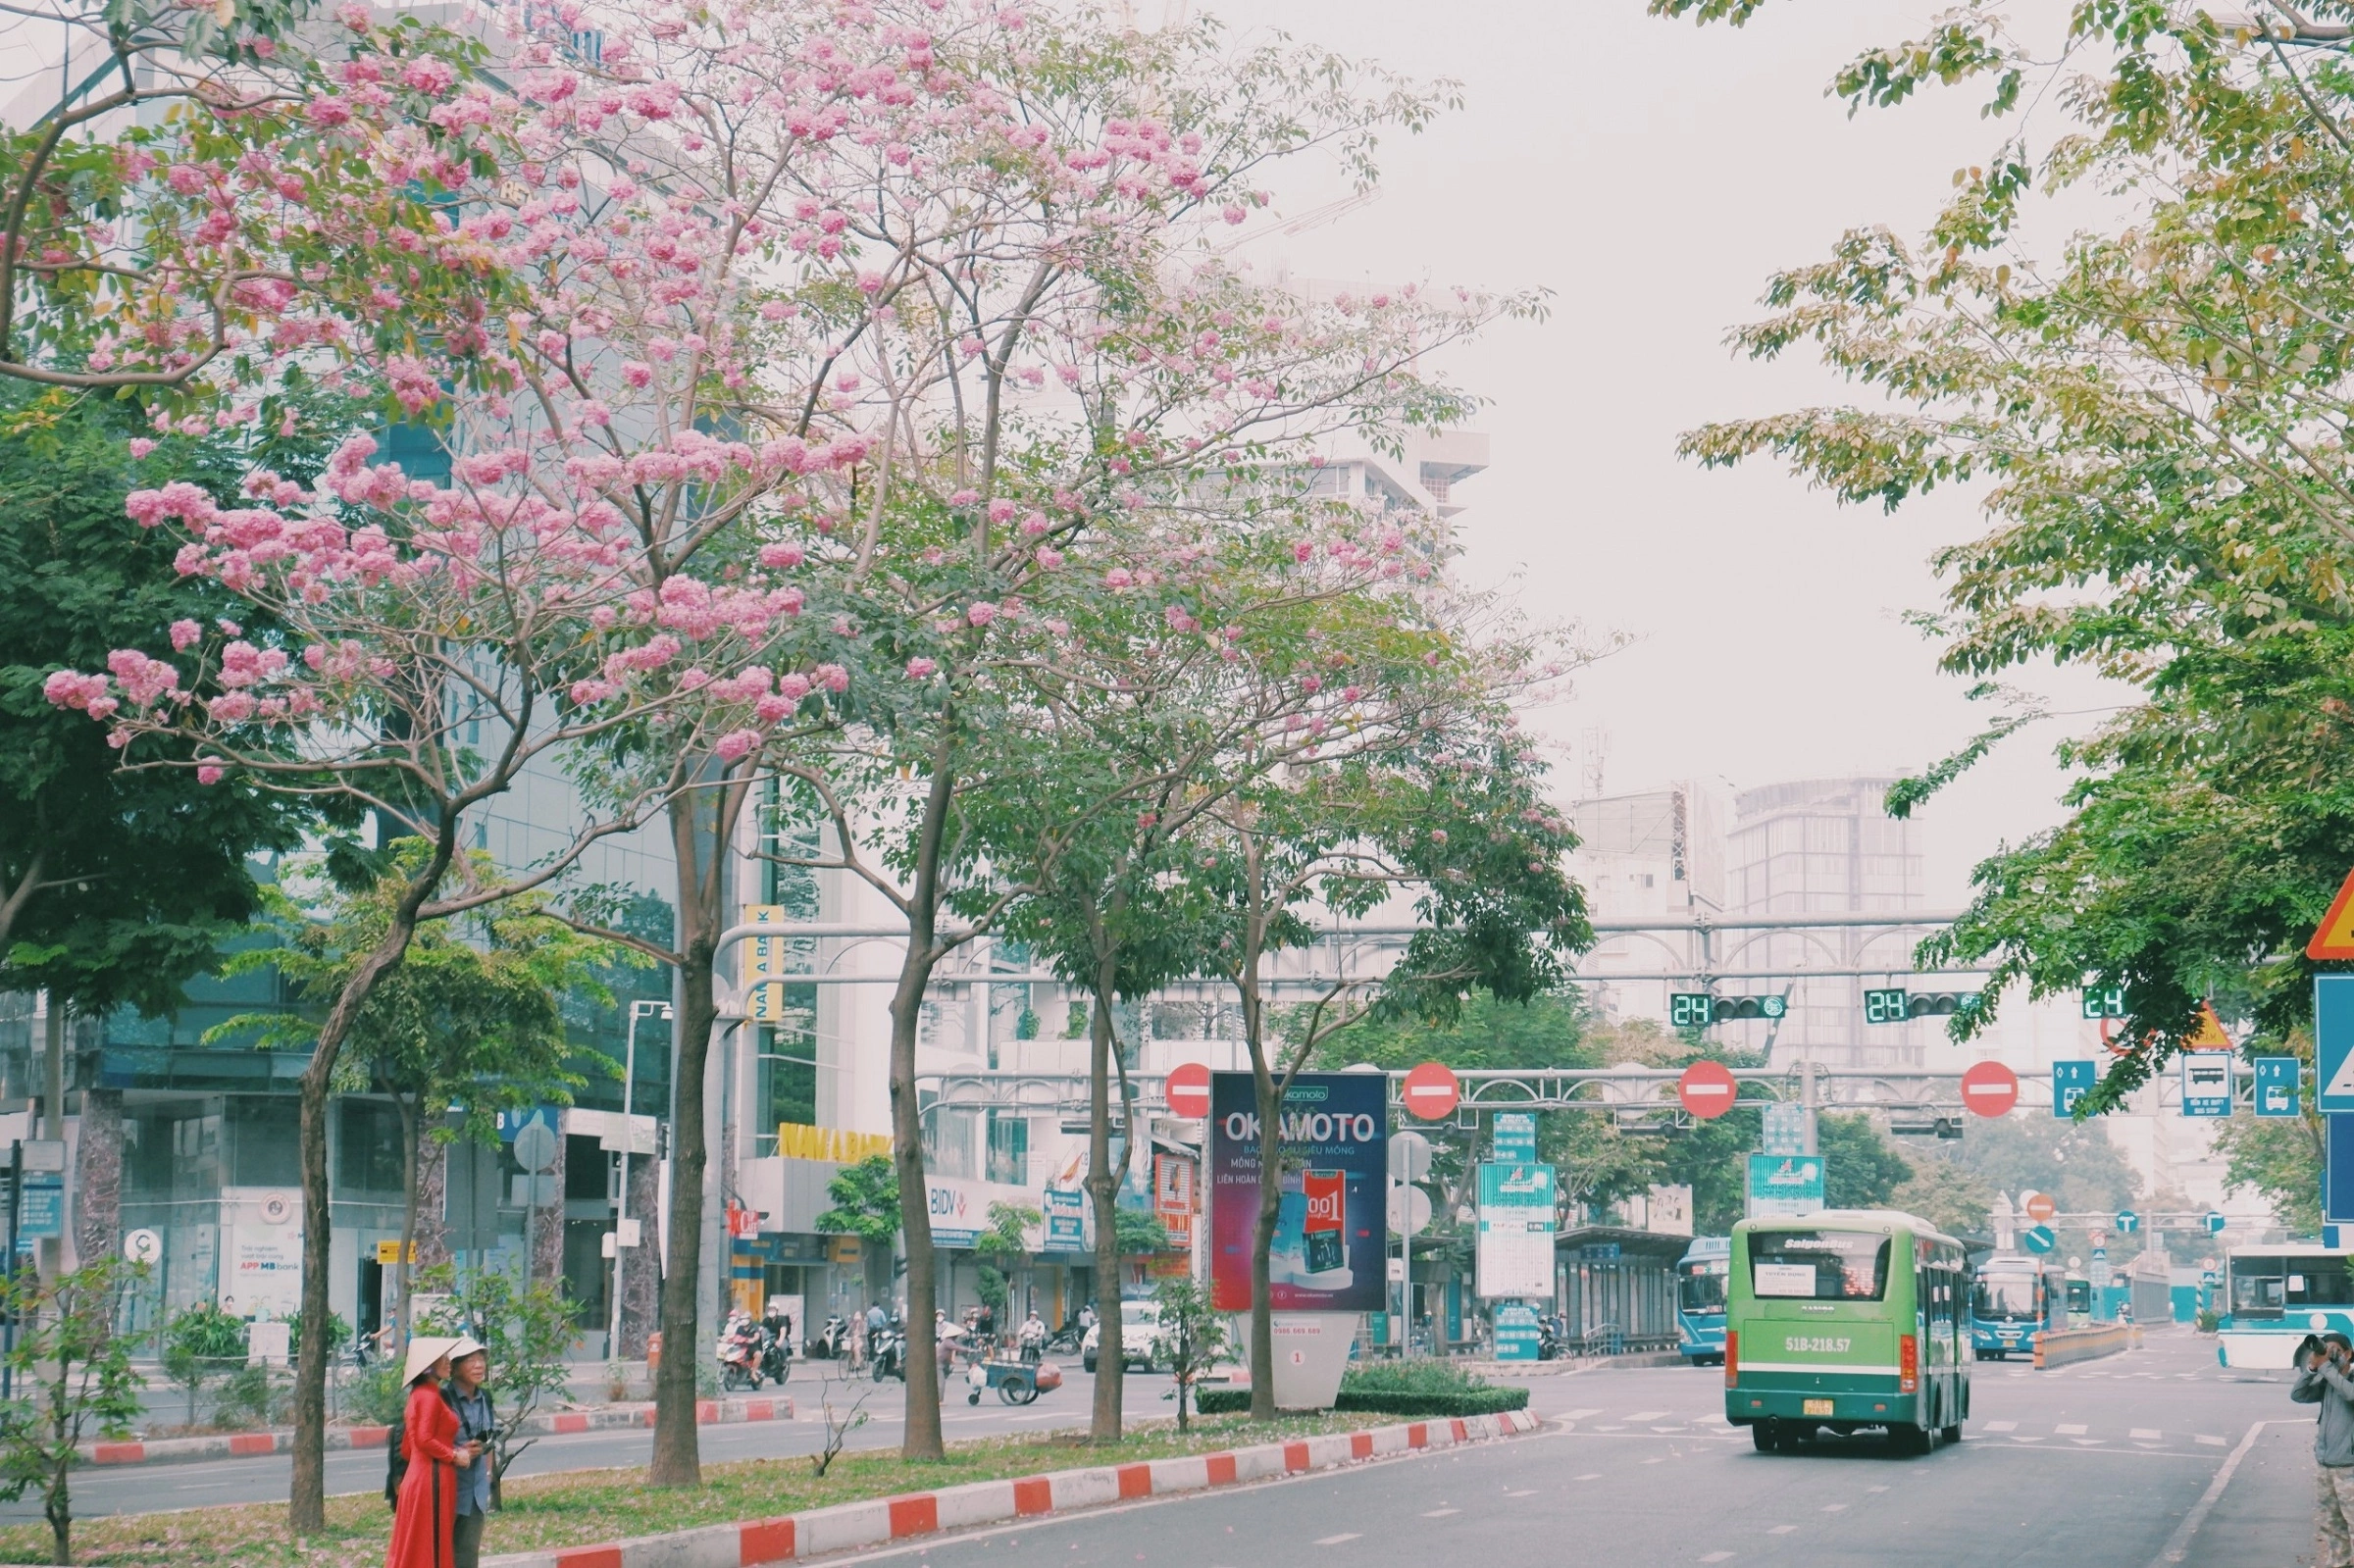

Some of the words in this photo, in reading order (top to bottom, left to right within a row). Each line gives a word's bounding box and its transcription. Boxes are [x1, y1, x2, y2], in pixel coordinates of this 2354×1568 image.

[758, 910, 769, 956] BAK
[757, 962, 766, 973] A
[1675, 995, 1708, 1024] 24
[1868, 992, 1904, 1020] 24
[1284, 1089, 1326, 1100] kamoto
[780, 1122, 829, 1161] NAM
[931, 1189, 956, 1216] BIDV
[1785, 1239, 1854, 1250] SaigonBus
[1785, 1337, 1851, 1352] 51B-218.57
[1295, 1352, 1301, 1364] 1
